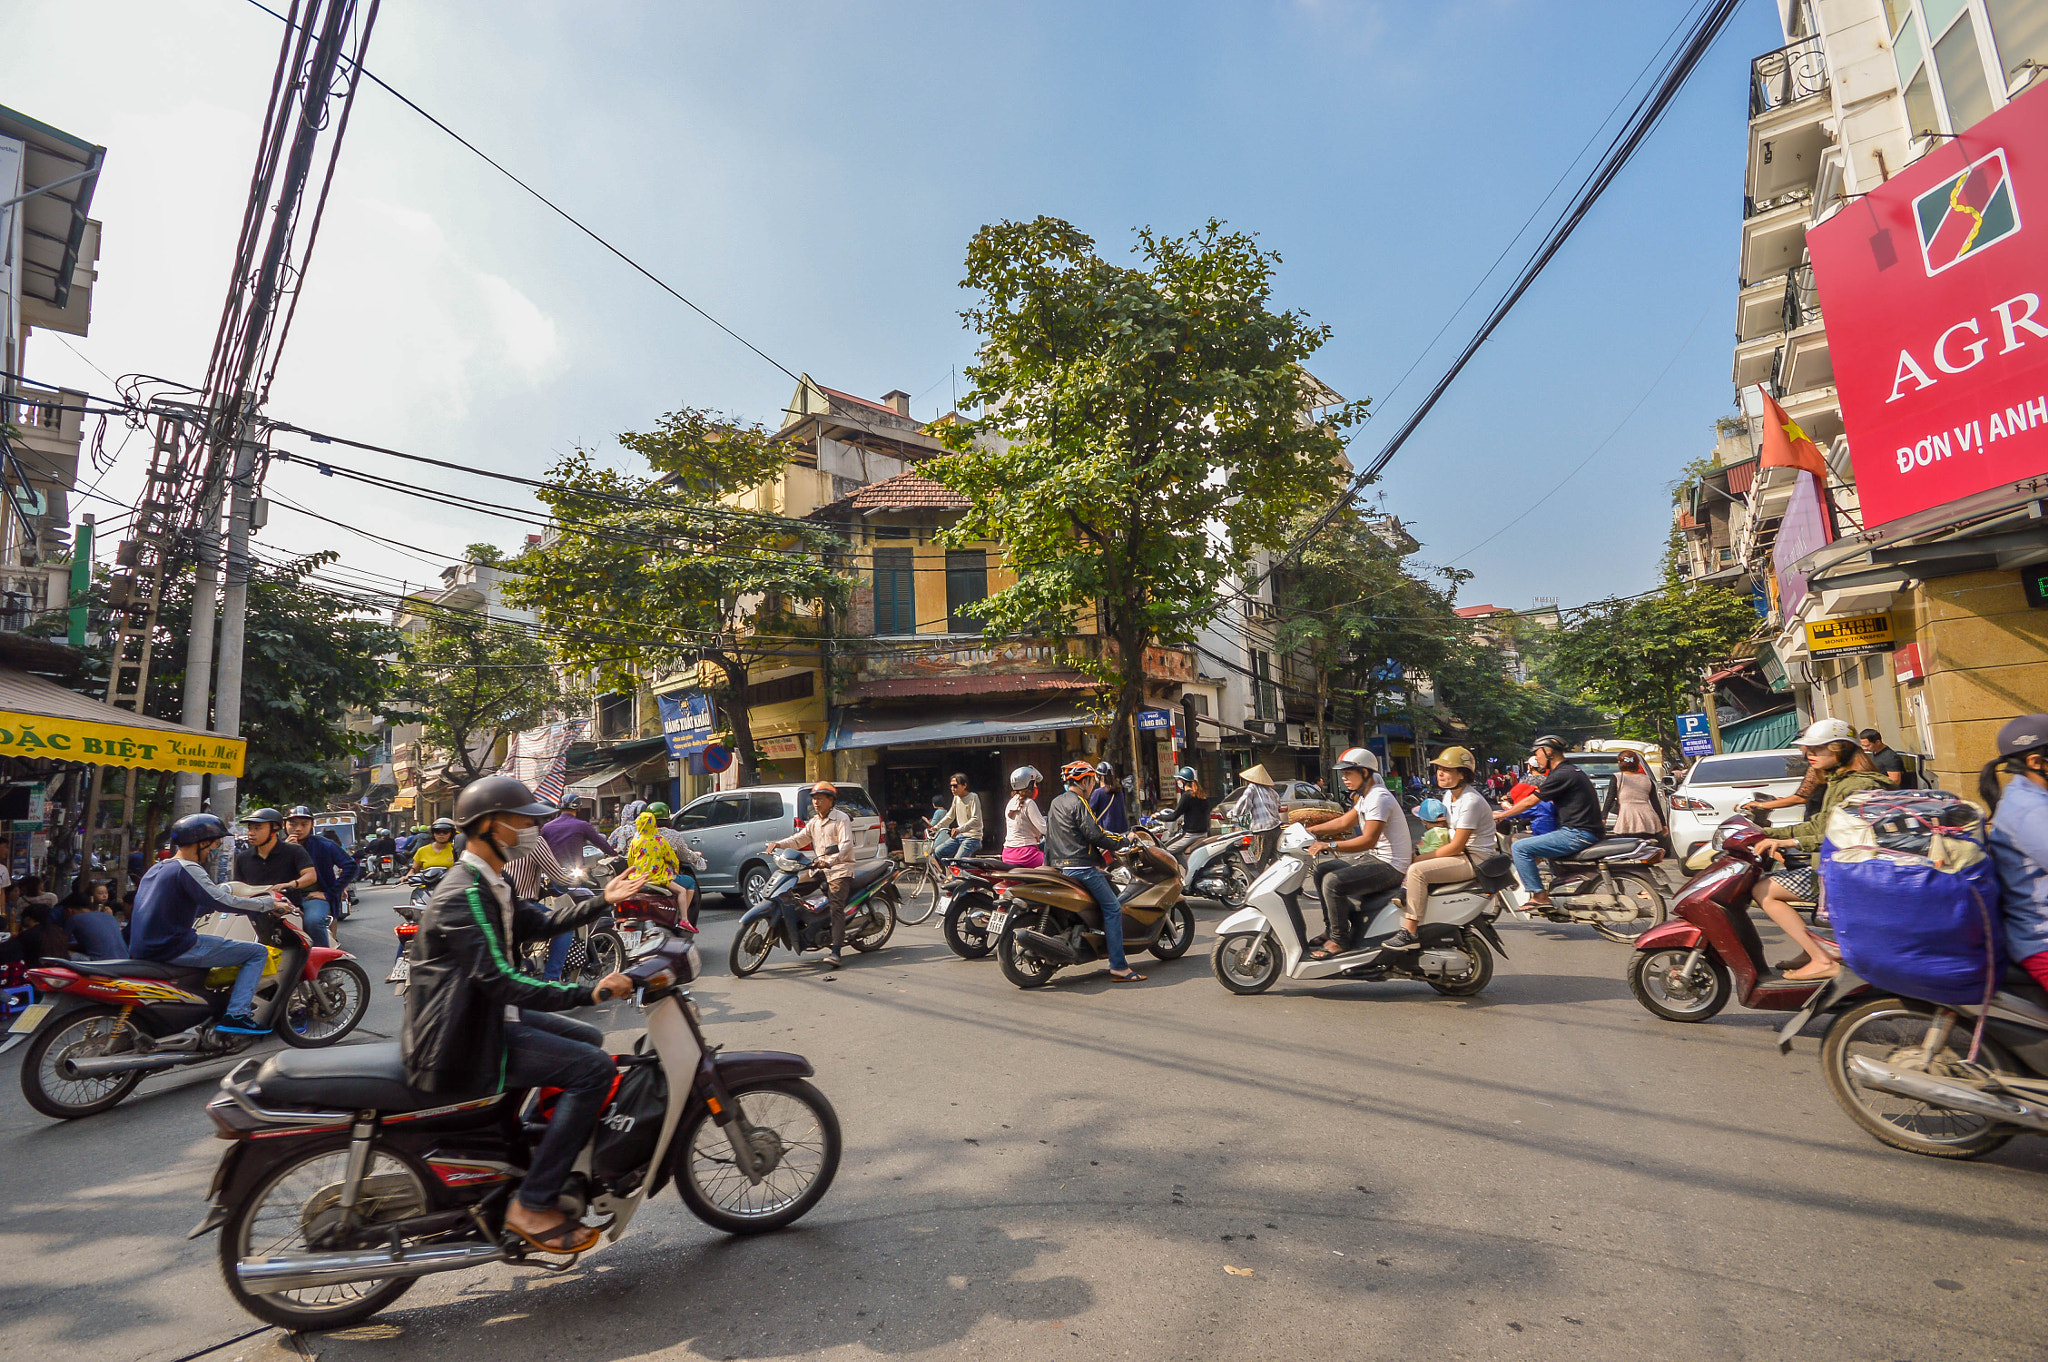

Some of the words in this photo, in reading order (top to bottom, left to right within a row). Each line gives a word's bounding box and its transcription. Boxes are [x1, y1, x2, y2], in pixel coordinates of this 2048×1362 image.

[1885, 293, 2048, 404] AGR
[1896, 431, 1952, 474] ĐƠN
[1953, 420, 1984, 455] VỊ
[1989, 395, 2048, 443] ANH
[1813, 619, 1874, 633] WESTERN
[1833, 625, 1875, 636] UNION
[1824, 637, 1849, 645] MONEY
[1850, 633, 1886, 642] TRANSFER
[1816, 648, 1843, 656] OVERSEAS
[1685, 717, 1699, 731] P
[82, 737, 158, 762] BIỆT
